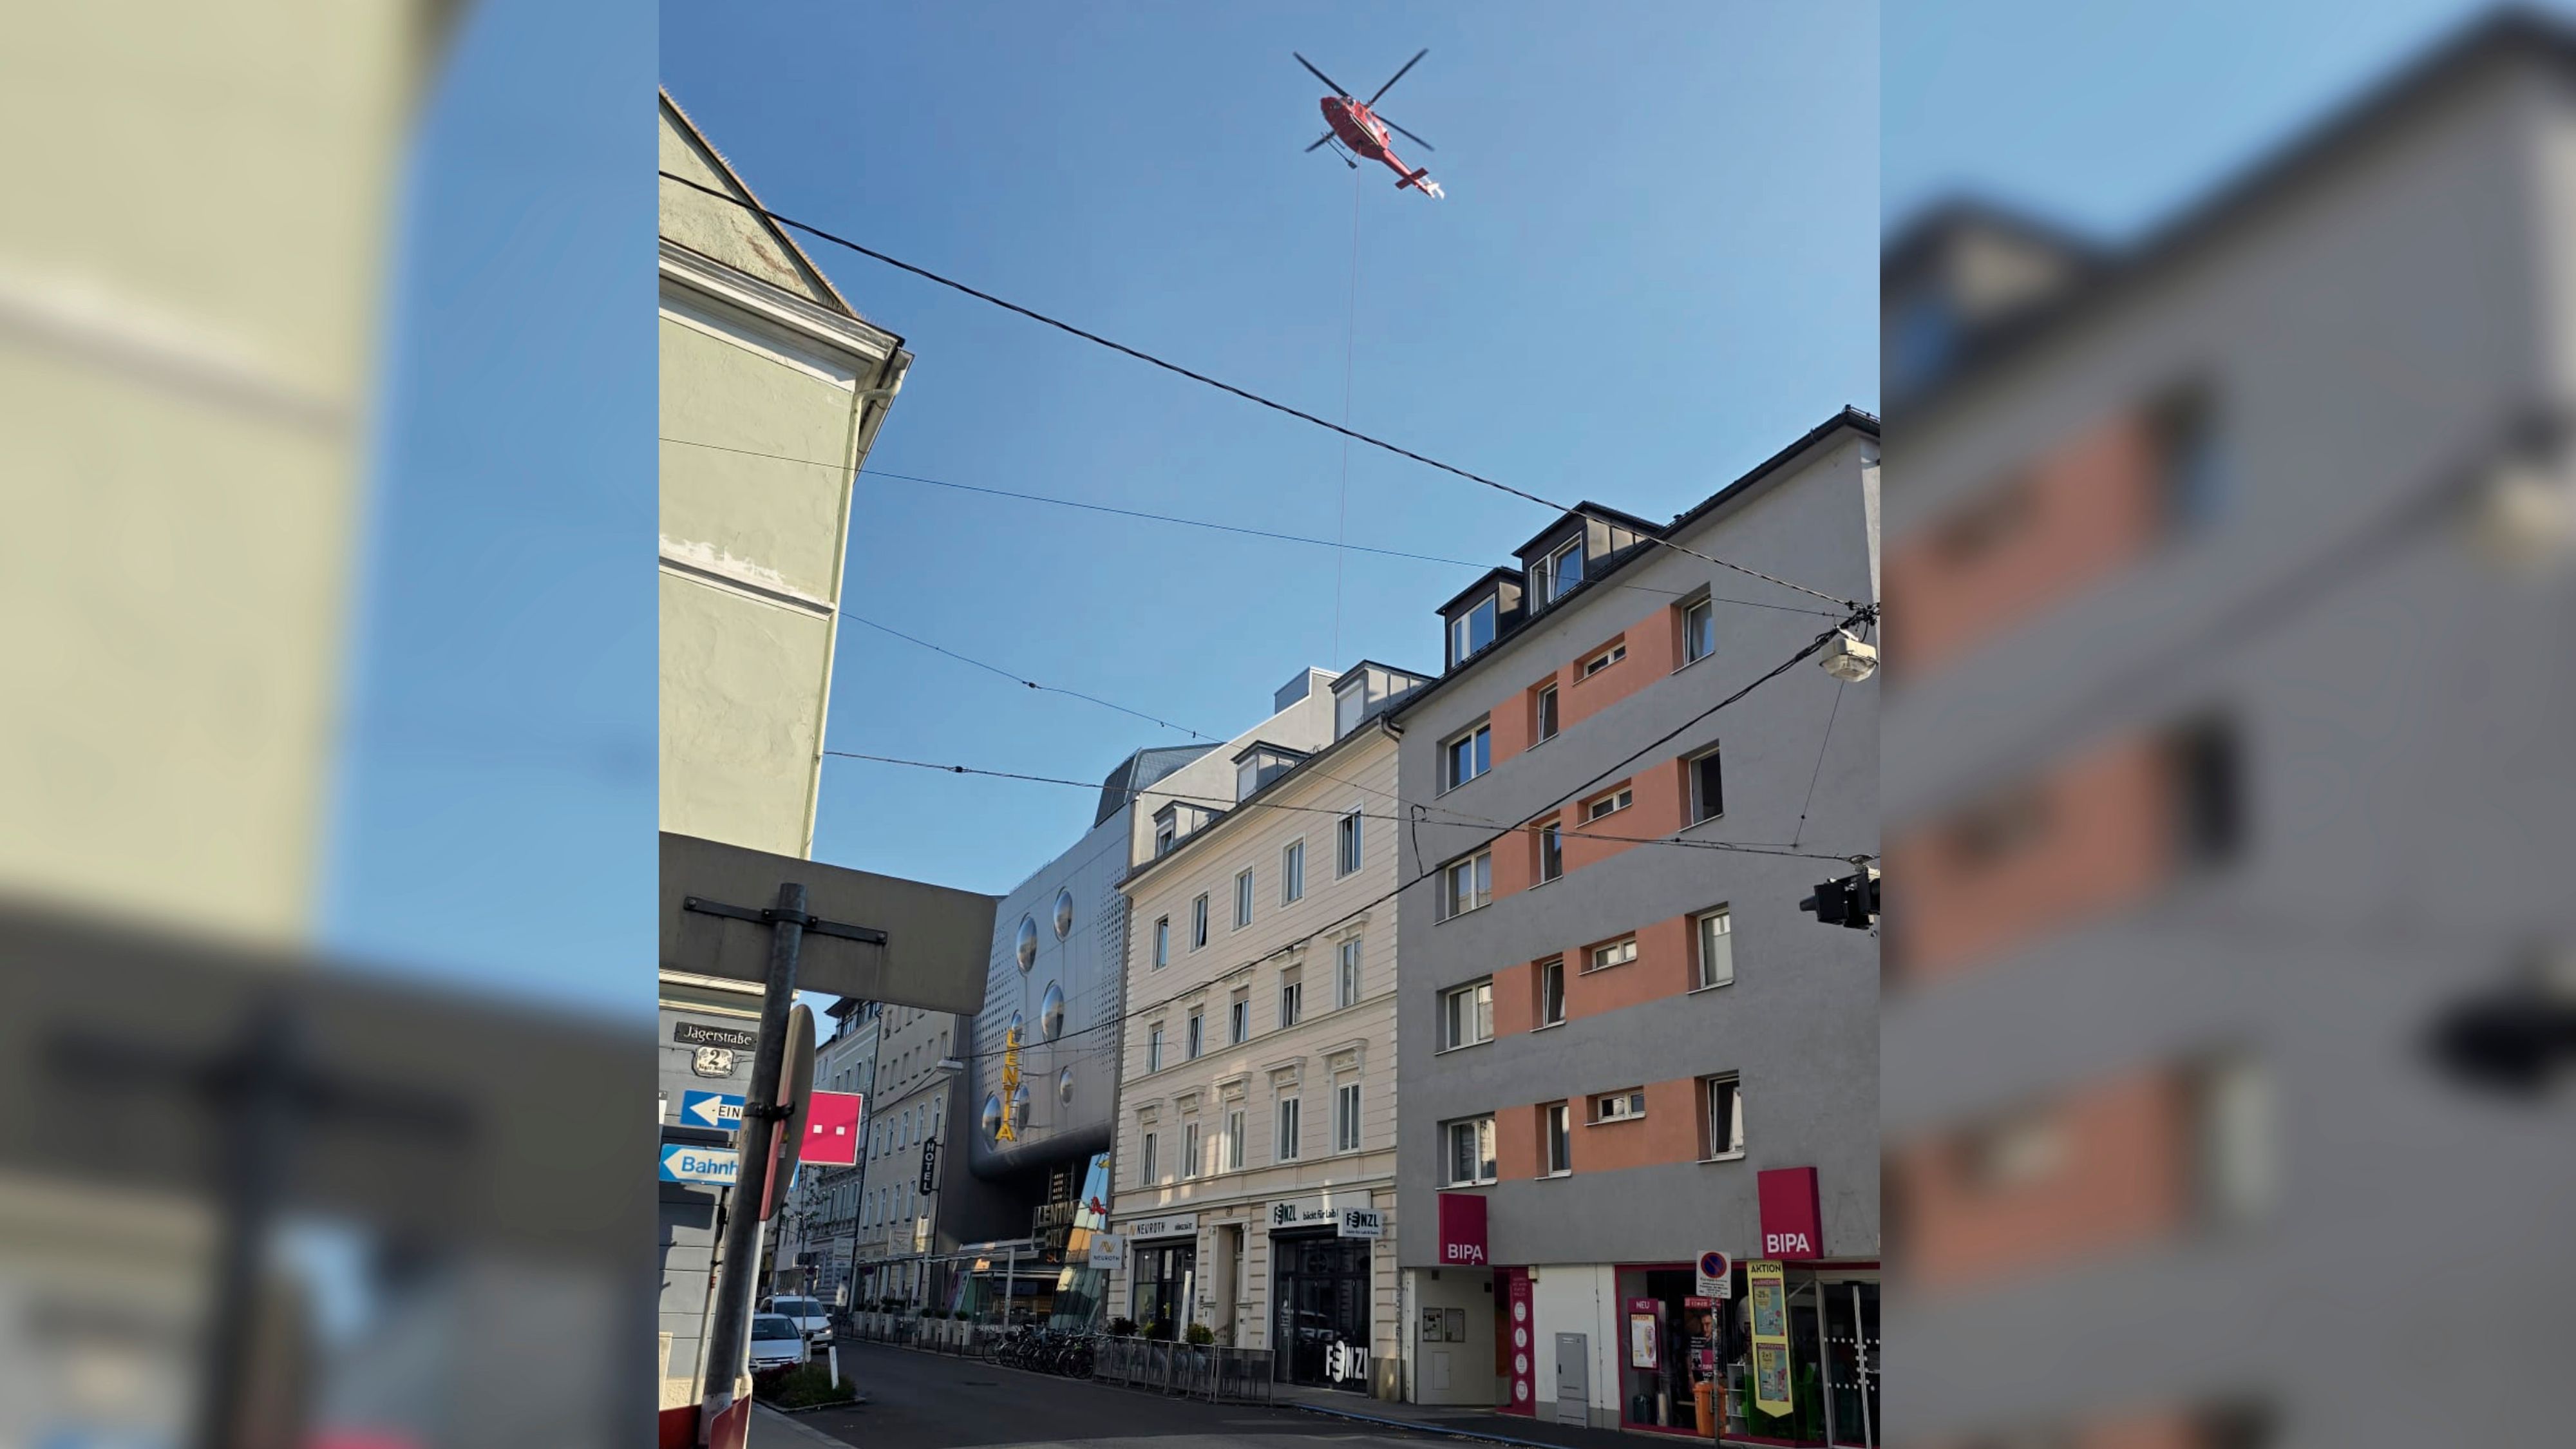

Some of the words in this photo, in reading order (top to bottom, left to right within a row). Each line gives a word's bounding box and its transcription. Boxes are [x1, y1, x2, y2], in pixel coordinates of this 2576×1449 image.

[684, 1026, 752, 1045] Jägerstraße
[708, 1049, 720, 1066] 2
[923, 1143, 934, 1191] HOTEL
[1137, 1222, 1165, 1235] NEUROTH
[1766, 1233, 1810, 1253] BIPA
[1448, 1244, 1483, 1260] BIPA
[1752, 1264, 1781, 1273] AKTION
